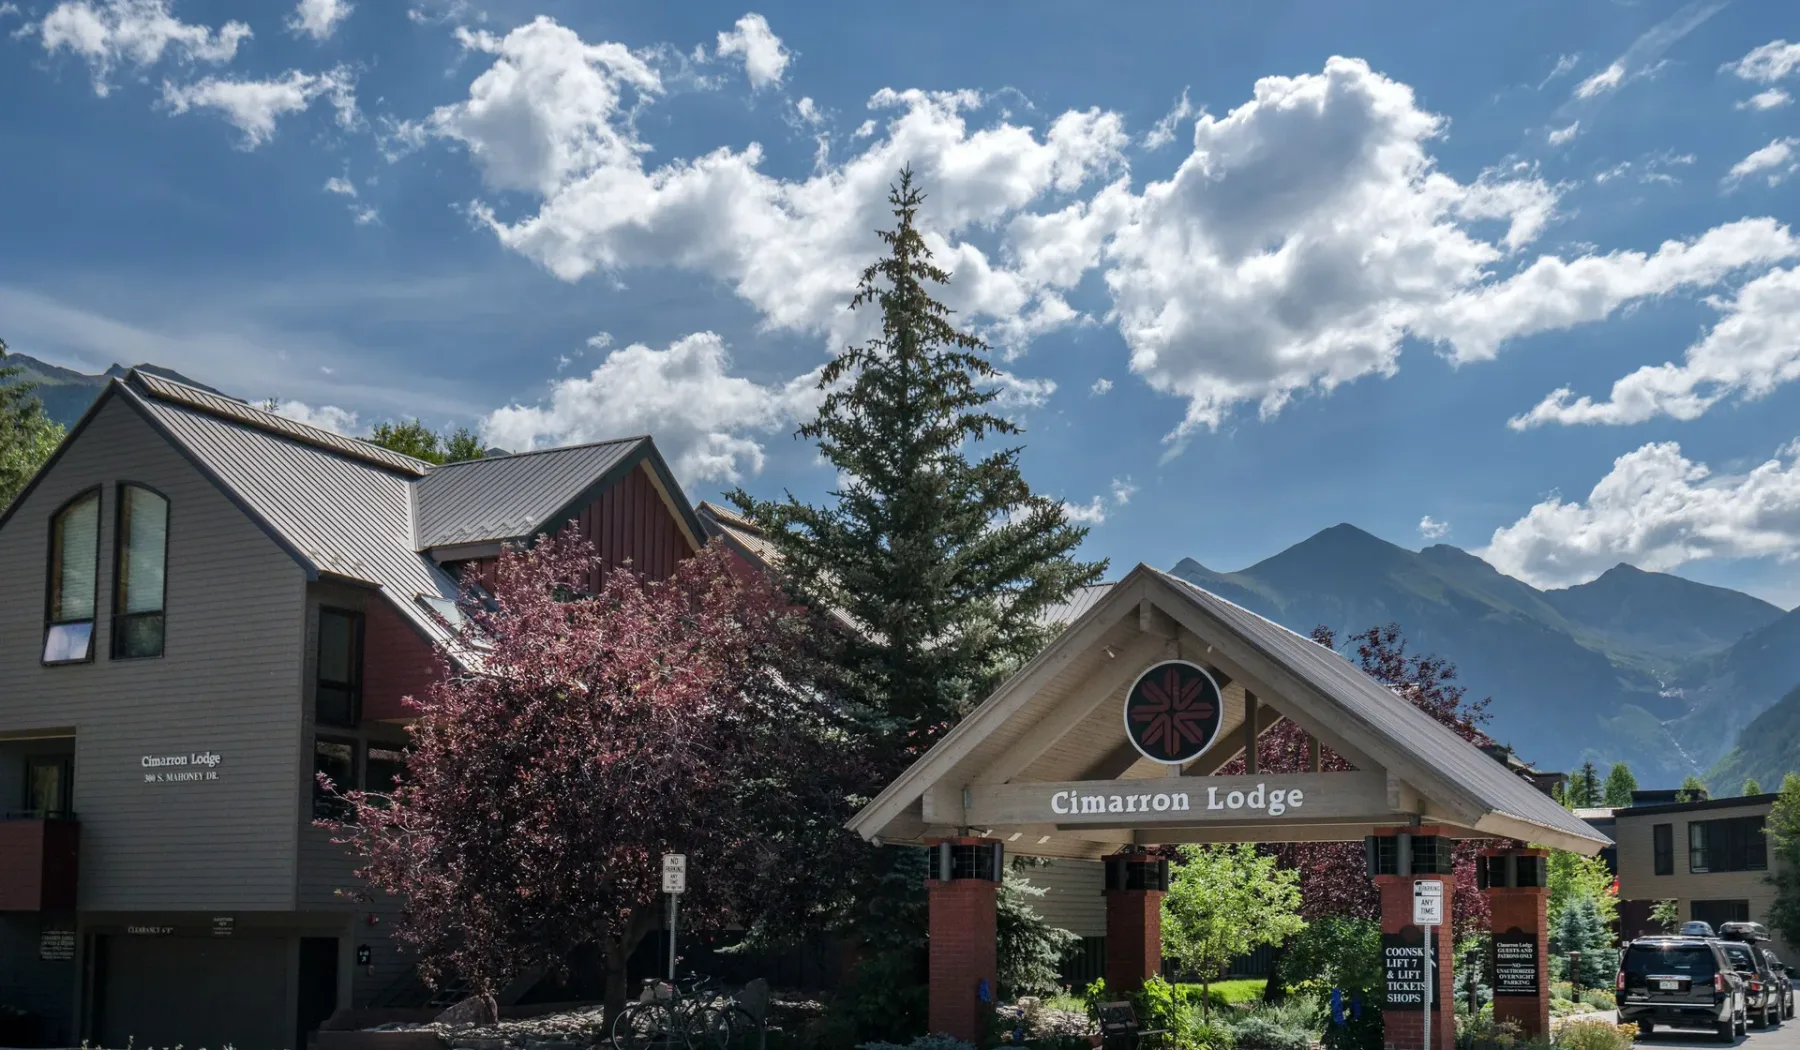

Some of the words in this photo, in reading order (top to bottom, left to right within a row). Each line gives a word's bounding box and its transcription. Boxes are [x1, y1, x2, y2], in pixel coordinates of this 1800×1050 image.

[141, 755, 187, 767] Cimarron
[191, 751, 221, 768] Lodge
[166, 772, 204, 782] MAHONEY
[206, 771, 219, 780] DR.
[1051, 790, 1190, 815] Cimarron
[1207, 783, 1304, 816] Lodge
[1420, 907, 1435, 915] TIME
[1385, 947, 1435, 957] COONSKN
[1386, 959, 1409, 968] LIFT
[1412, 959, 1418, 968] 7
[1386, 970, 1394, 979] &
[1398, 970, 1421, 979] LIFT
[1387, 981, 1425, 991] TICKETS
[1387, 994, 1421, 1003] SHOPS
